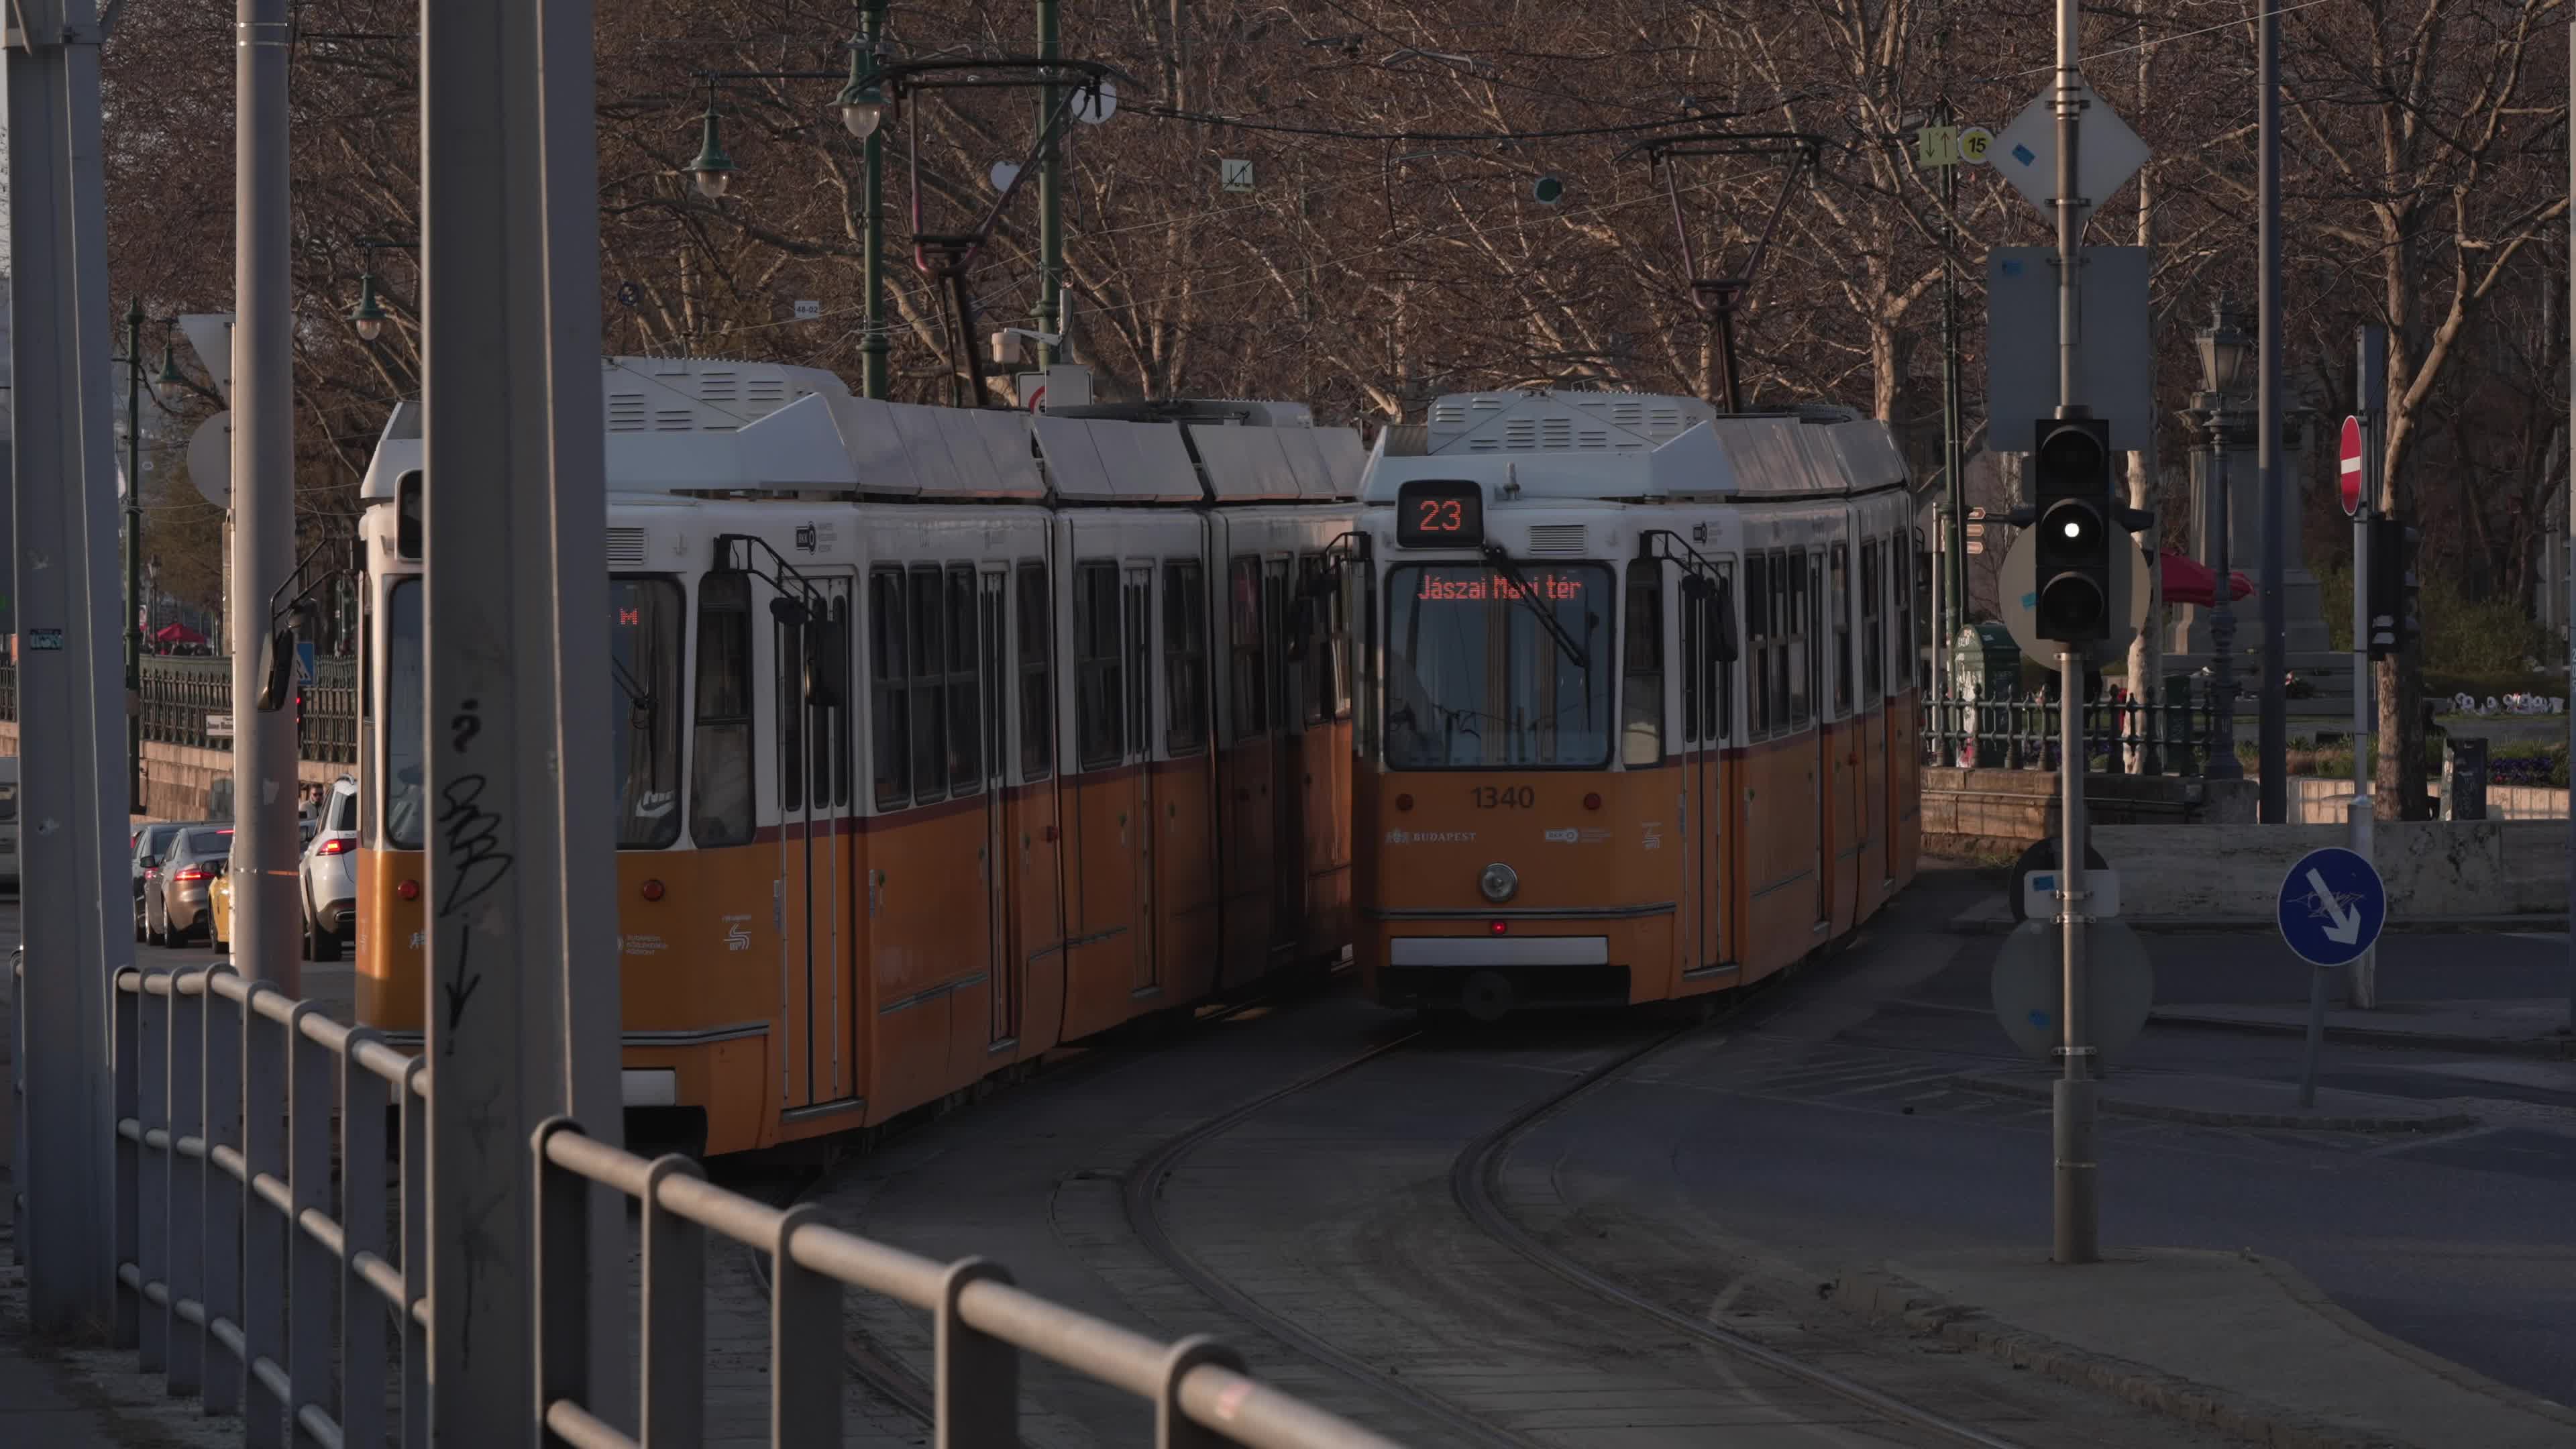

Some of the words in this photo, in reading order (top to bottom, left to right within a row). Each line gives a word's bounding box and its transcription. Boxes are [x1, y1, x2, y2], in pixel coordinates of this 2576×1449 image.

[1969, 138, 1986, 153] 15
[796, 305, 818, 313] 48-02
[1419, 500, 1460, 531] 23
[1417, 574, 1487, 599] Jászai
[1546, 574, 1582, 599] tér
[1470, 786, 1536, 809] 1340
[1412, 830, 1477, 843] BUDAPEST
